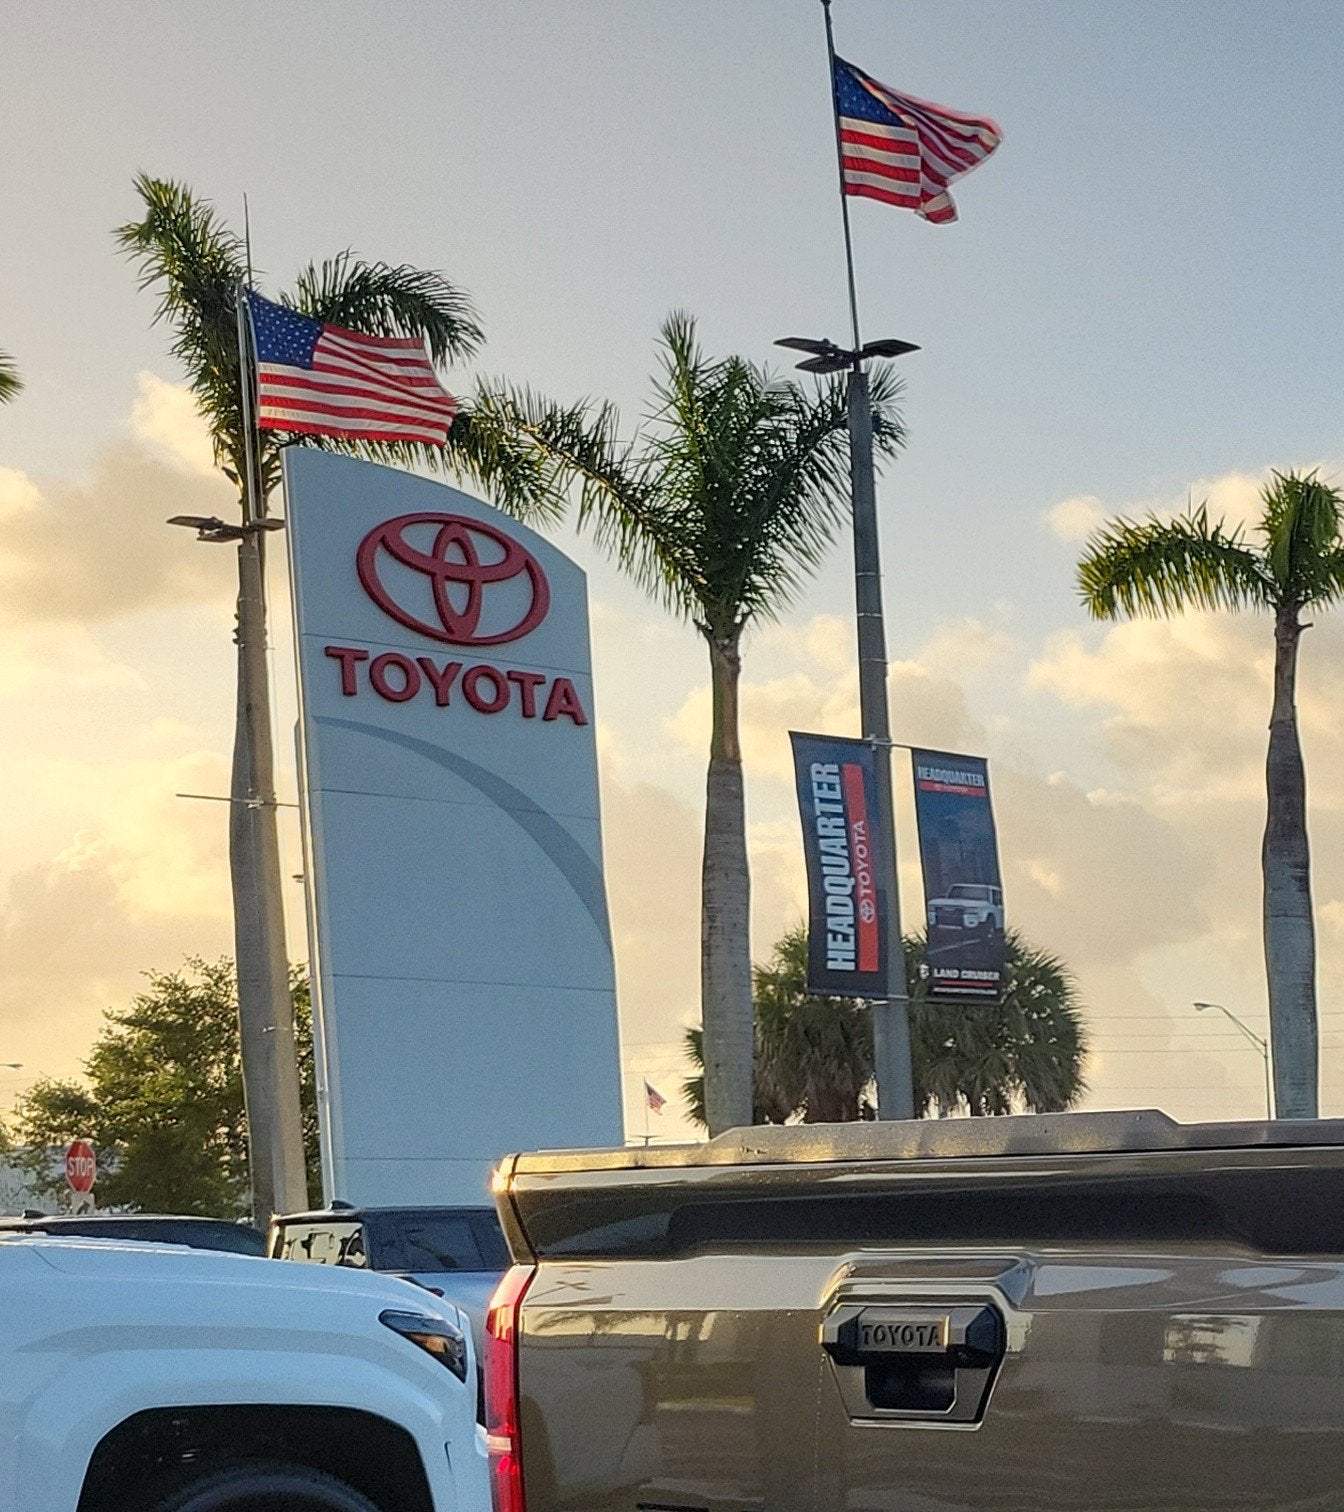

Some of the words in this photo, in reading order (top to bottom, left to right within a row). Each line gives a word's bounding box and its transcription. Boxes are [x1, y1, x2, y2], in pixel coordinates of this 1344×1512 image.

[324, 645, 589, 726] TOYOTA
[811, 762, 856, 971] HEADQUARTER
[853, 820, 873, 897] TOYOTA
[933, 968, 960, 979] LAND
[68, 1156, 94, 1177] STOP
[861, 1324, 942, 1348] TOYOTA
